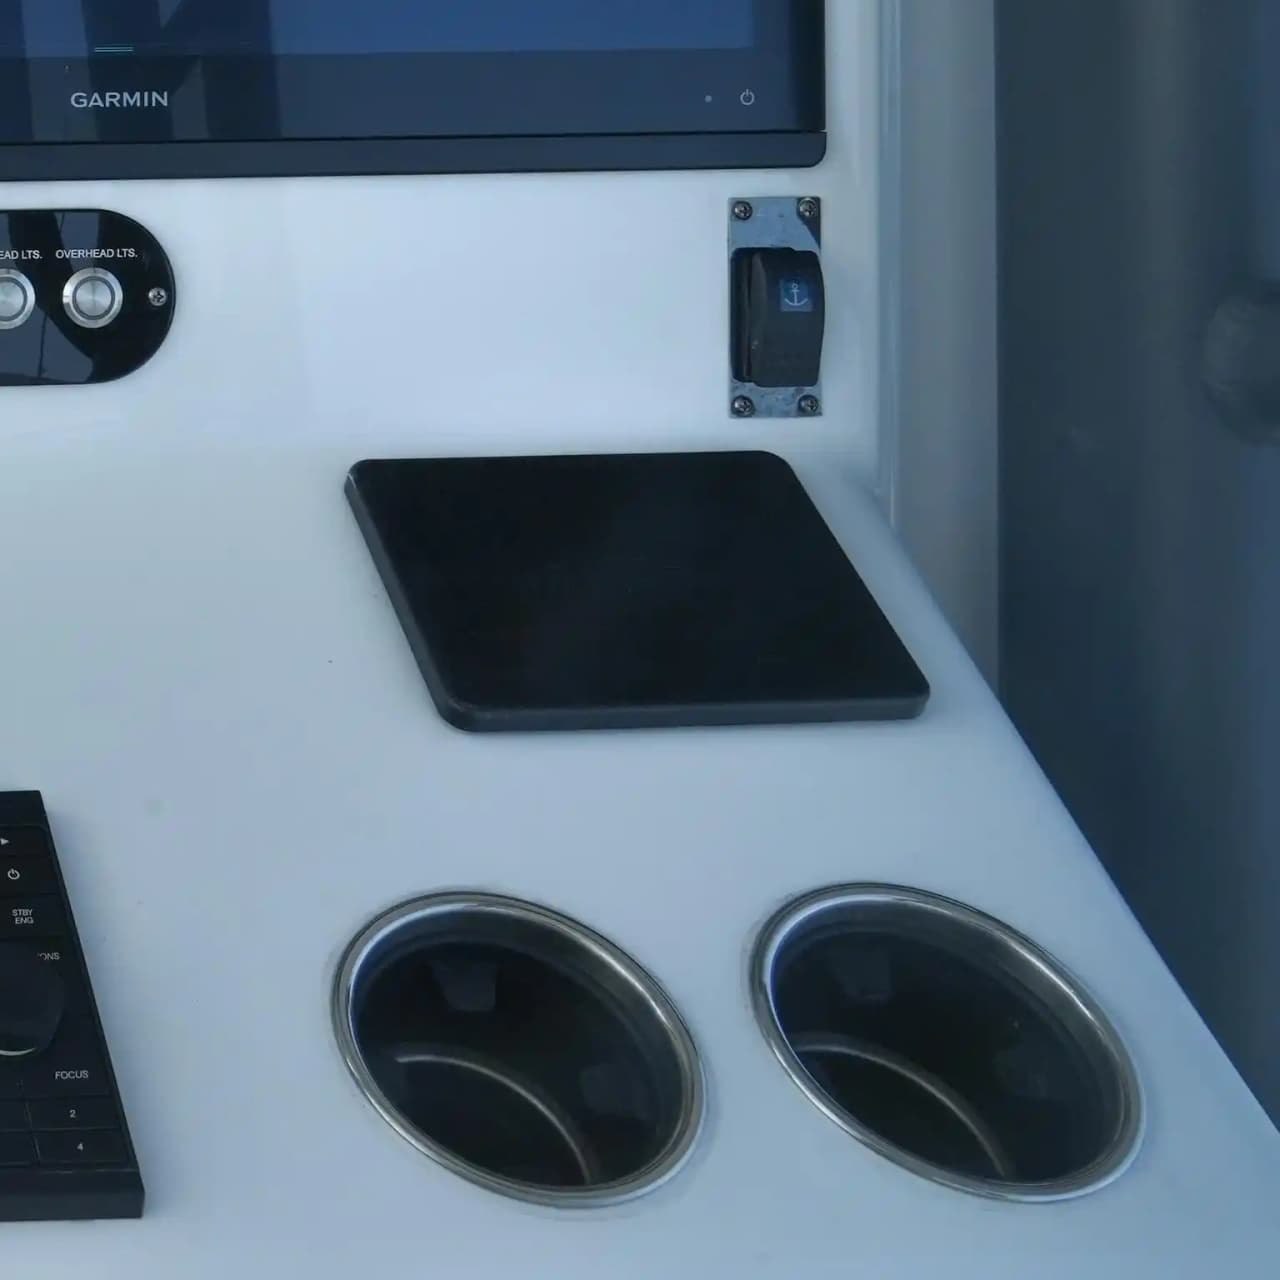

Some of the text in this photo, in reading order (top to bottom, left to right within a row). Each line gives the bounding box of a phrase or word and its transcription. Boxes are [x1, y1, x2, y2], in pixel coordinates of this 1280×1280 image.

[69, 90, 169, 109] GARMIN
[21, 249, 43, 260] LTS.
[55, 248, 138, 260] OVERHEAD LTS.
[55, 1070, 89, 1080] FOCUS
